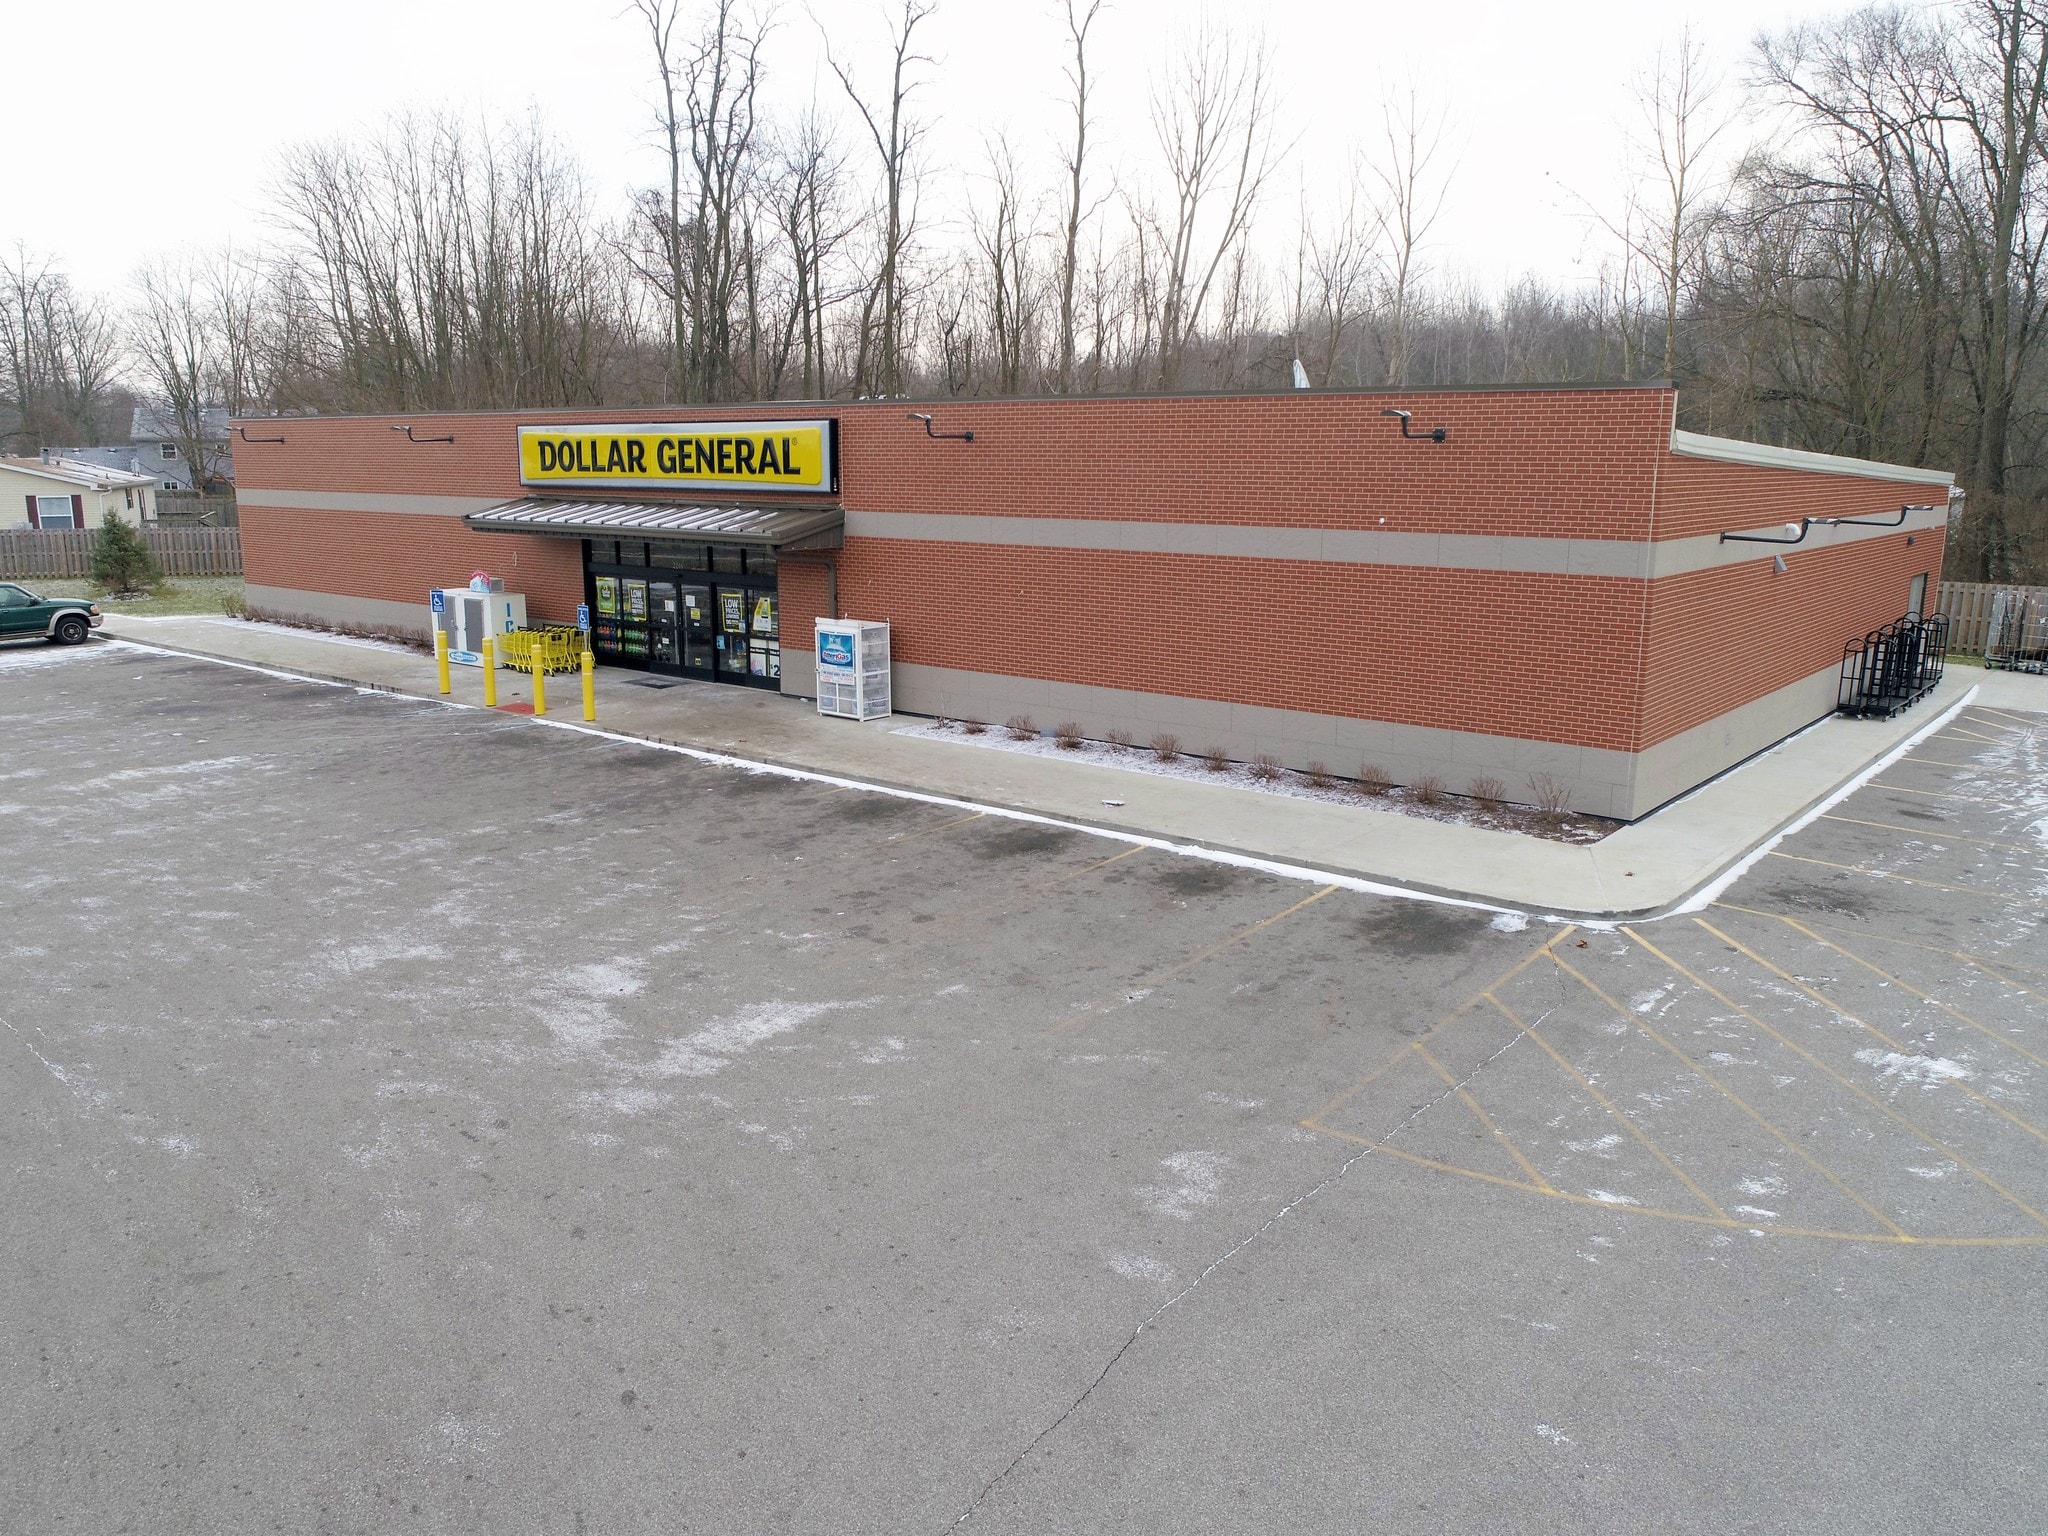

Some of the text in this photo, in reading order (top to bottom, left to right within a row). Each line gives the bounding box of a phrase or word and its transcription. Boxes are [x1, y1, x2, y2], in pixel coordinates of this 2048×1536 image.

[538, 437, 800, 475] DOLLAR GENERAL
[725, 599, 738, 608] LOW
[823, 651, 850, 661] AmeriGas
